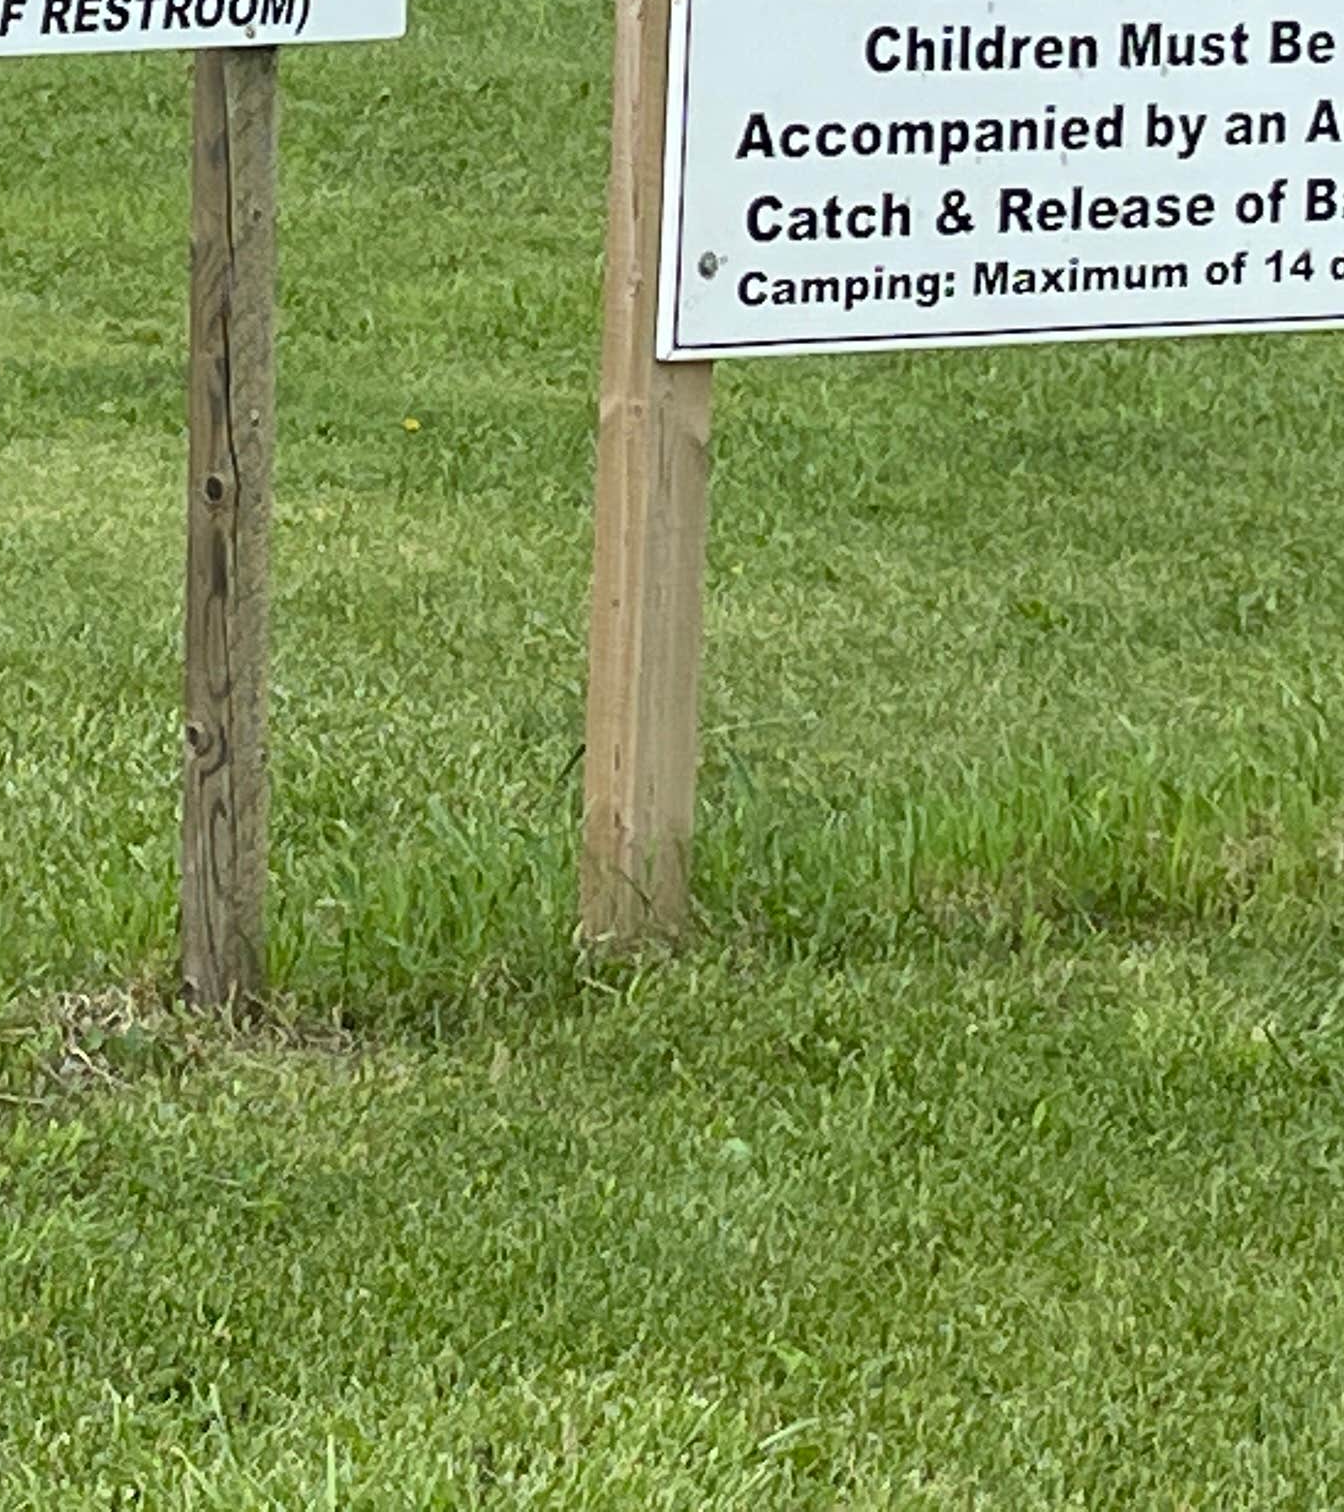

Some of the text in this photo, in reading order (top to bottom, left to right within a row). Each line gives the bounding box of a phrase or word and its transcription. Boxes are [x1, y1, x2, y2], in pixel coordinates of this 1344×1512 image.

[865, 20, 1336, 73] Children Must Be
[735, 104, 1124, 166] Accompanied
[1146, 103, 1207, 160] by
[1225, 111, 1286, 147] an
[746, 192, 911, 242] Catch
[935, 189, 975, 236] &
[998, 185, 1215, 234] Release
[1235, 178, 1288, 225] of
[737, 266, 955, 312] Camping:
[973, 257, 1188, 296] Maximum
[1205, 251, 1249, 287] of
[1264, 249, 1315, 283] 14
